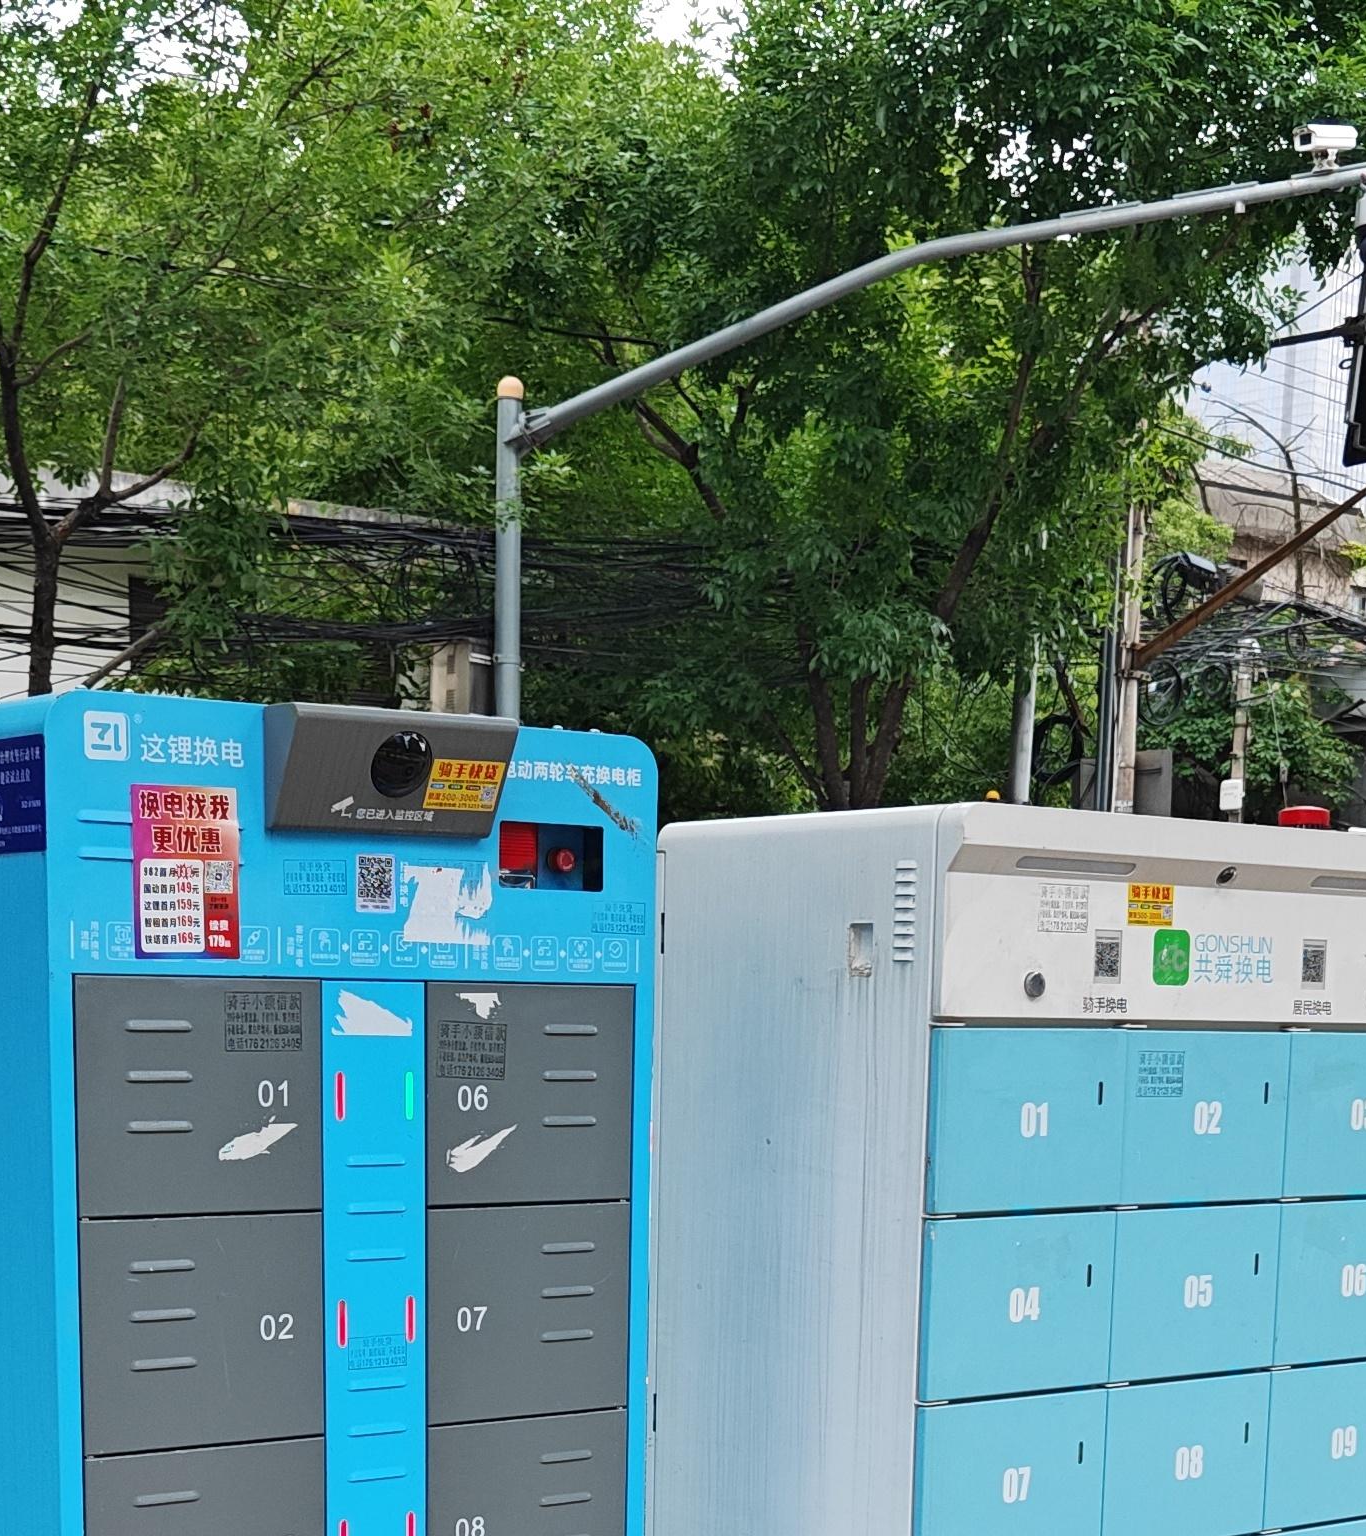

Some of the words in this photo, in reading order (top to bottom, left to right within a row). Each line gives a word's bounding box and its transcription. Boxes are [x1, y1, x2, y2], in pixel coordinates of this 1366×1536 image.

[140, 733, 244, 768] 这锂换电
[439, 762, 499, 780] 骑手快贷
[507, 760, 642, 787] 电动两轮车充换电柜
[140, 791, 229, 820] 换电找我
[356, 808, 435, 822] 您已进入监控区域
[152, 826, 222, 853] 更优惠
[1132, 885, 1170, 900] 骑手快贷
[145, 932, 201, 944] 铁塔首月169元
[1195, 934, 1273, 954] GONSHUN
[1194, 956, 1273, 984] 共舜换电
[1083, 997, 1128, 1014] 骑手换电
[1293, 1000, 1332, 1016] 居民换电
[258, 1080, 288, 1108] 01
[457, 1085, 489, 1112] 06
[1020, 1102, 1049, 1138] 01
[1193, 1101, 1222, 1135] 02
[1009, 1287, 1040, 1323] 04
[1184, 1274, 1213, 1309] 05
[260, 1313, 294, 1341] 02
[457, 1306, 488, 1332] 07
[1331, 1425, 1357, 1460] 09
[1175, 1445, 1204, 1481] 08
[1002, 1466, 1031, 1504] 07
